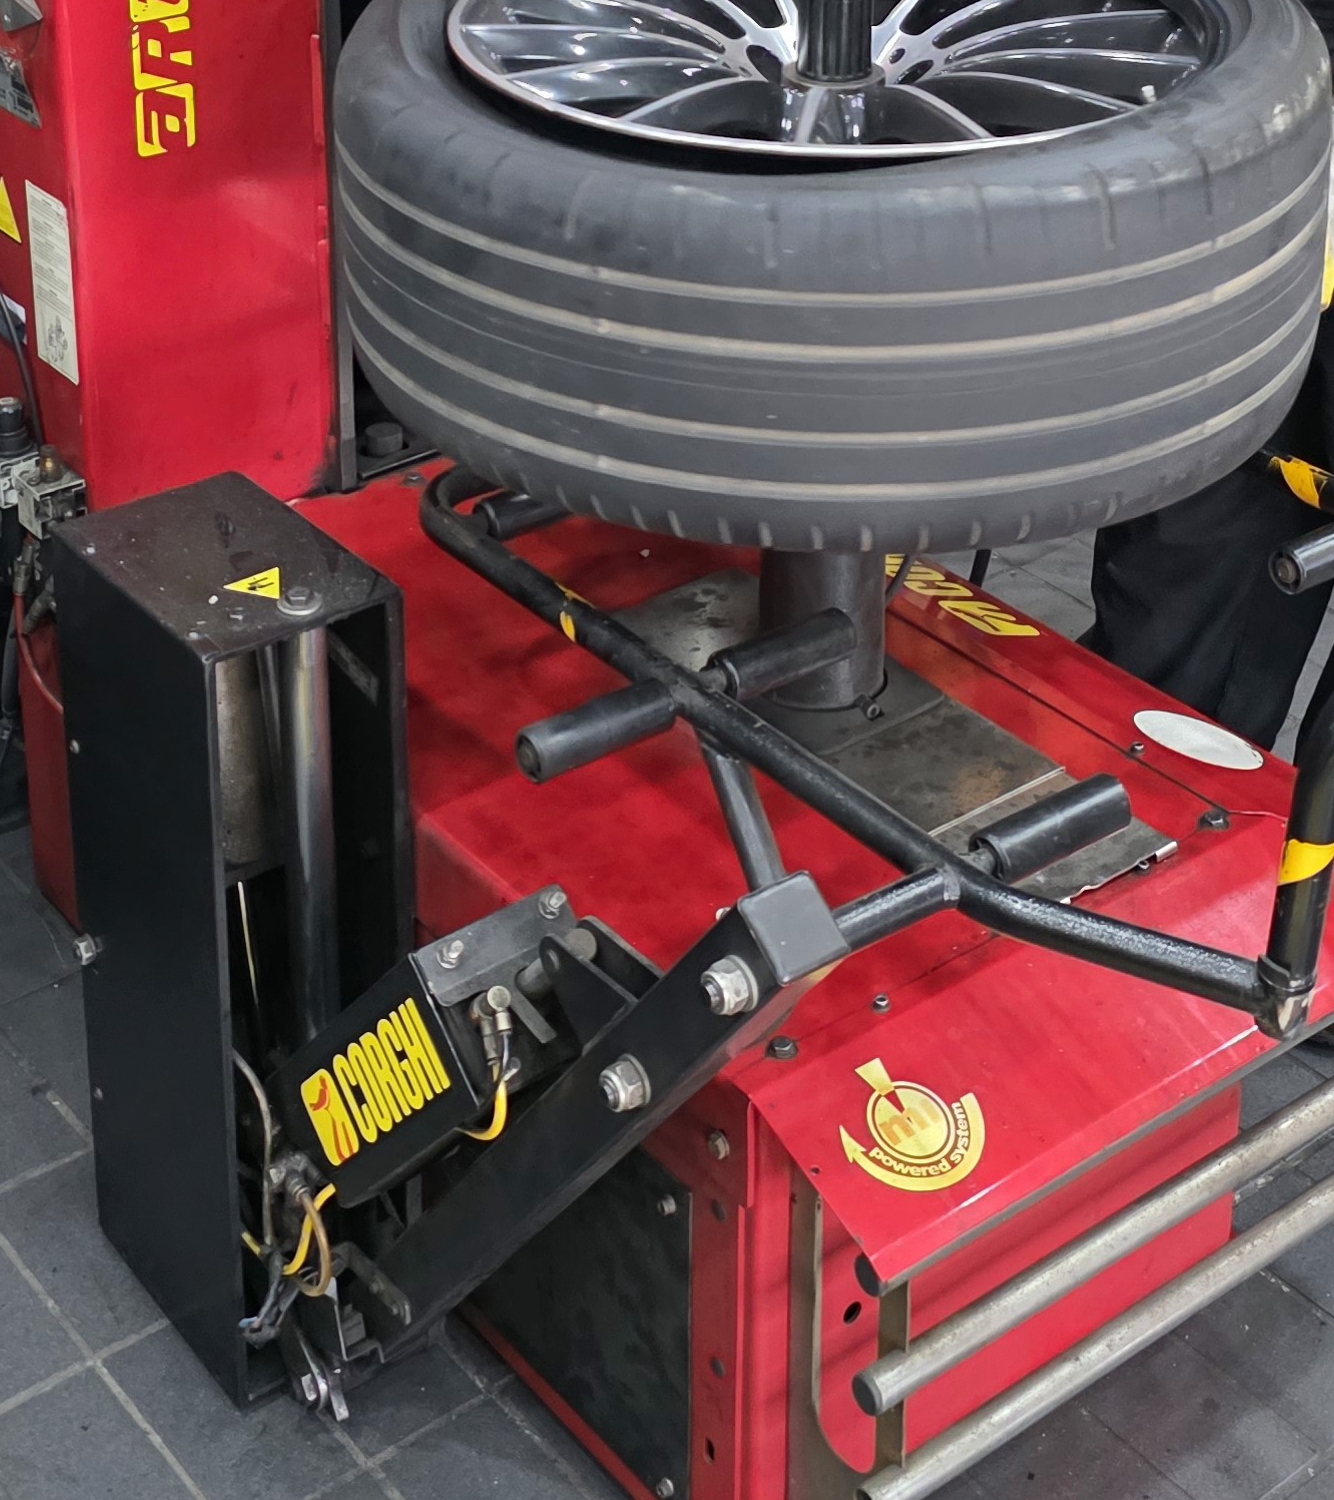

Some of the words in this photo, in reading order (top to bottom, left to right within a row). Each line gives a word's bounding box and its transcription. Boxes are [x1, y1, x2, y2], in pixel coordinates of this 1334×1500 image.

[333, 997, 451, 1143] CORGHI
[868, 1145, 952, 1178] powered
[951, 1101, 970, 1165] system
